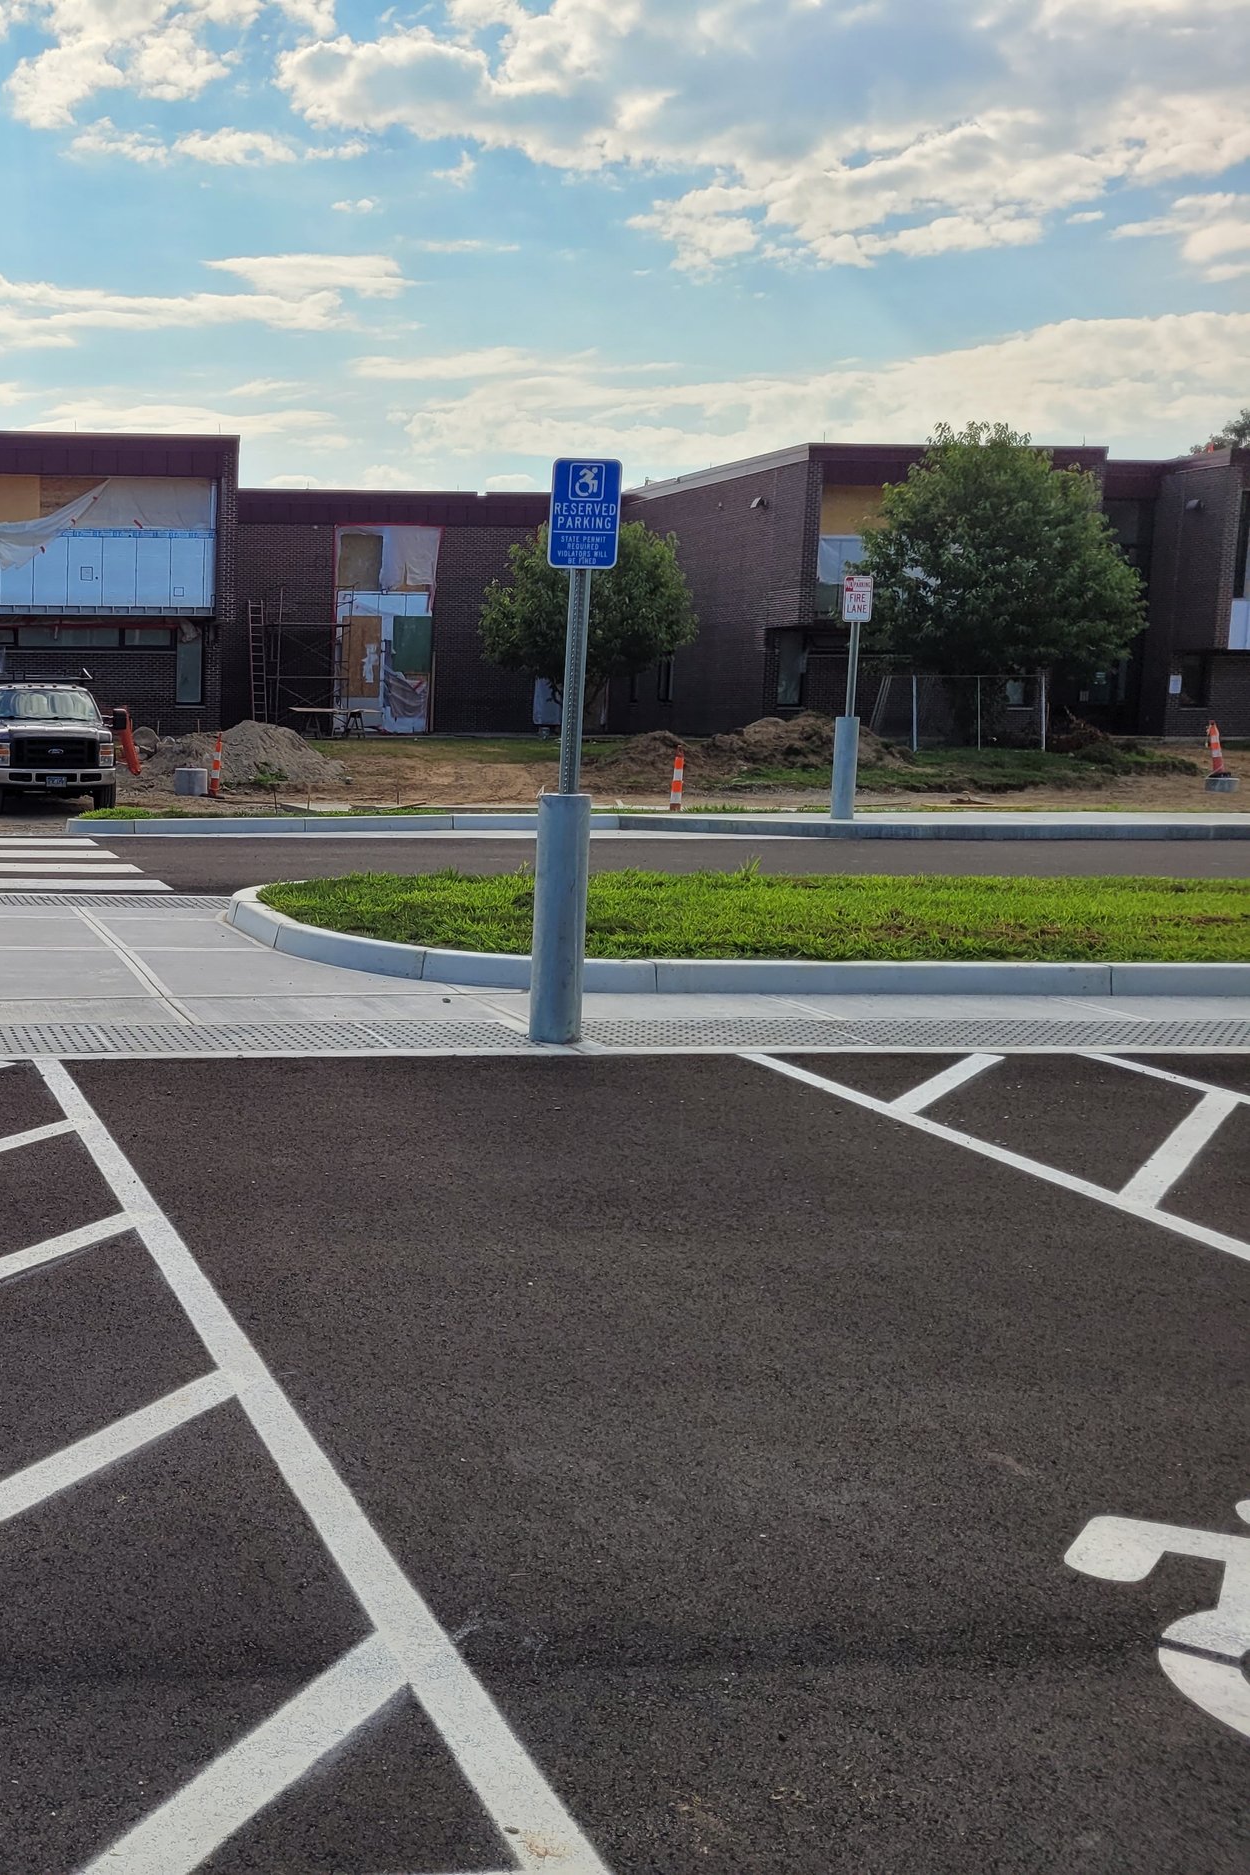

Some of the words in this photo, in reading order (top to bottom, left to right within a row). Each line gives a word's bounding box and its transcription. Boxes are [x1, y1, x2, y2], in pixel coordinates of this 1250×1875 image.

[554, 502, 617, 516] RESERVED
[557, 516, 612, 529] PARKING
[560, 535, 580, 543] STATE
[849, 593, 866, 602] FIRE
[847, 604, 868, 613] LANE
